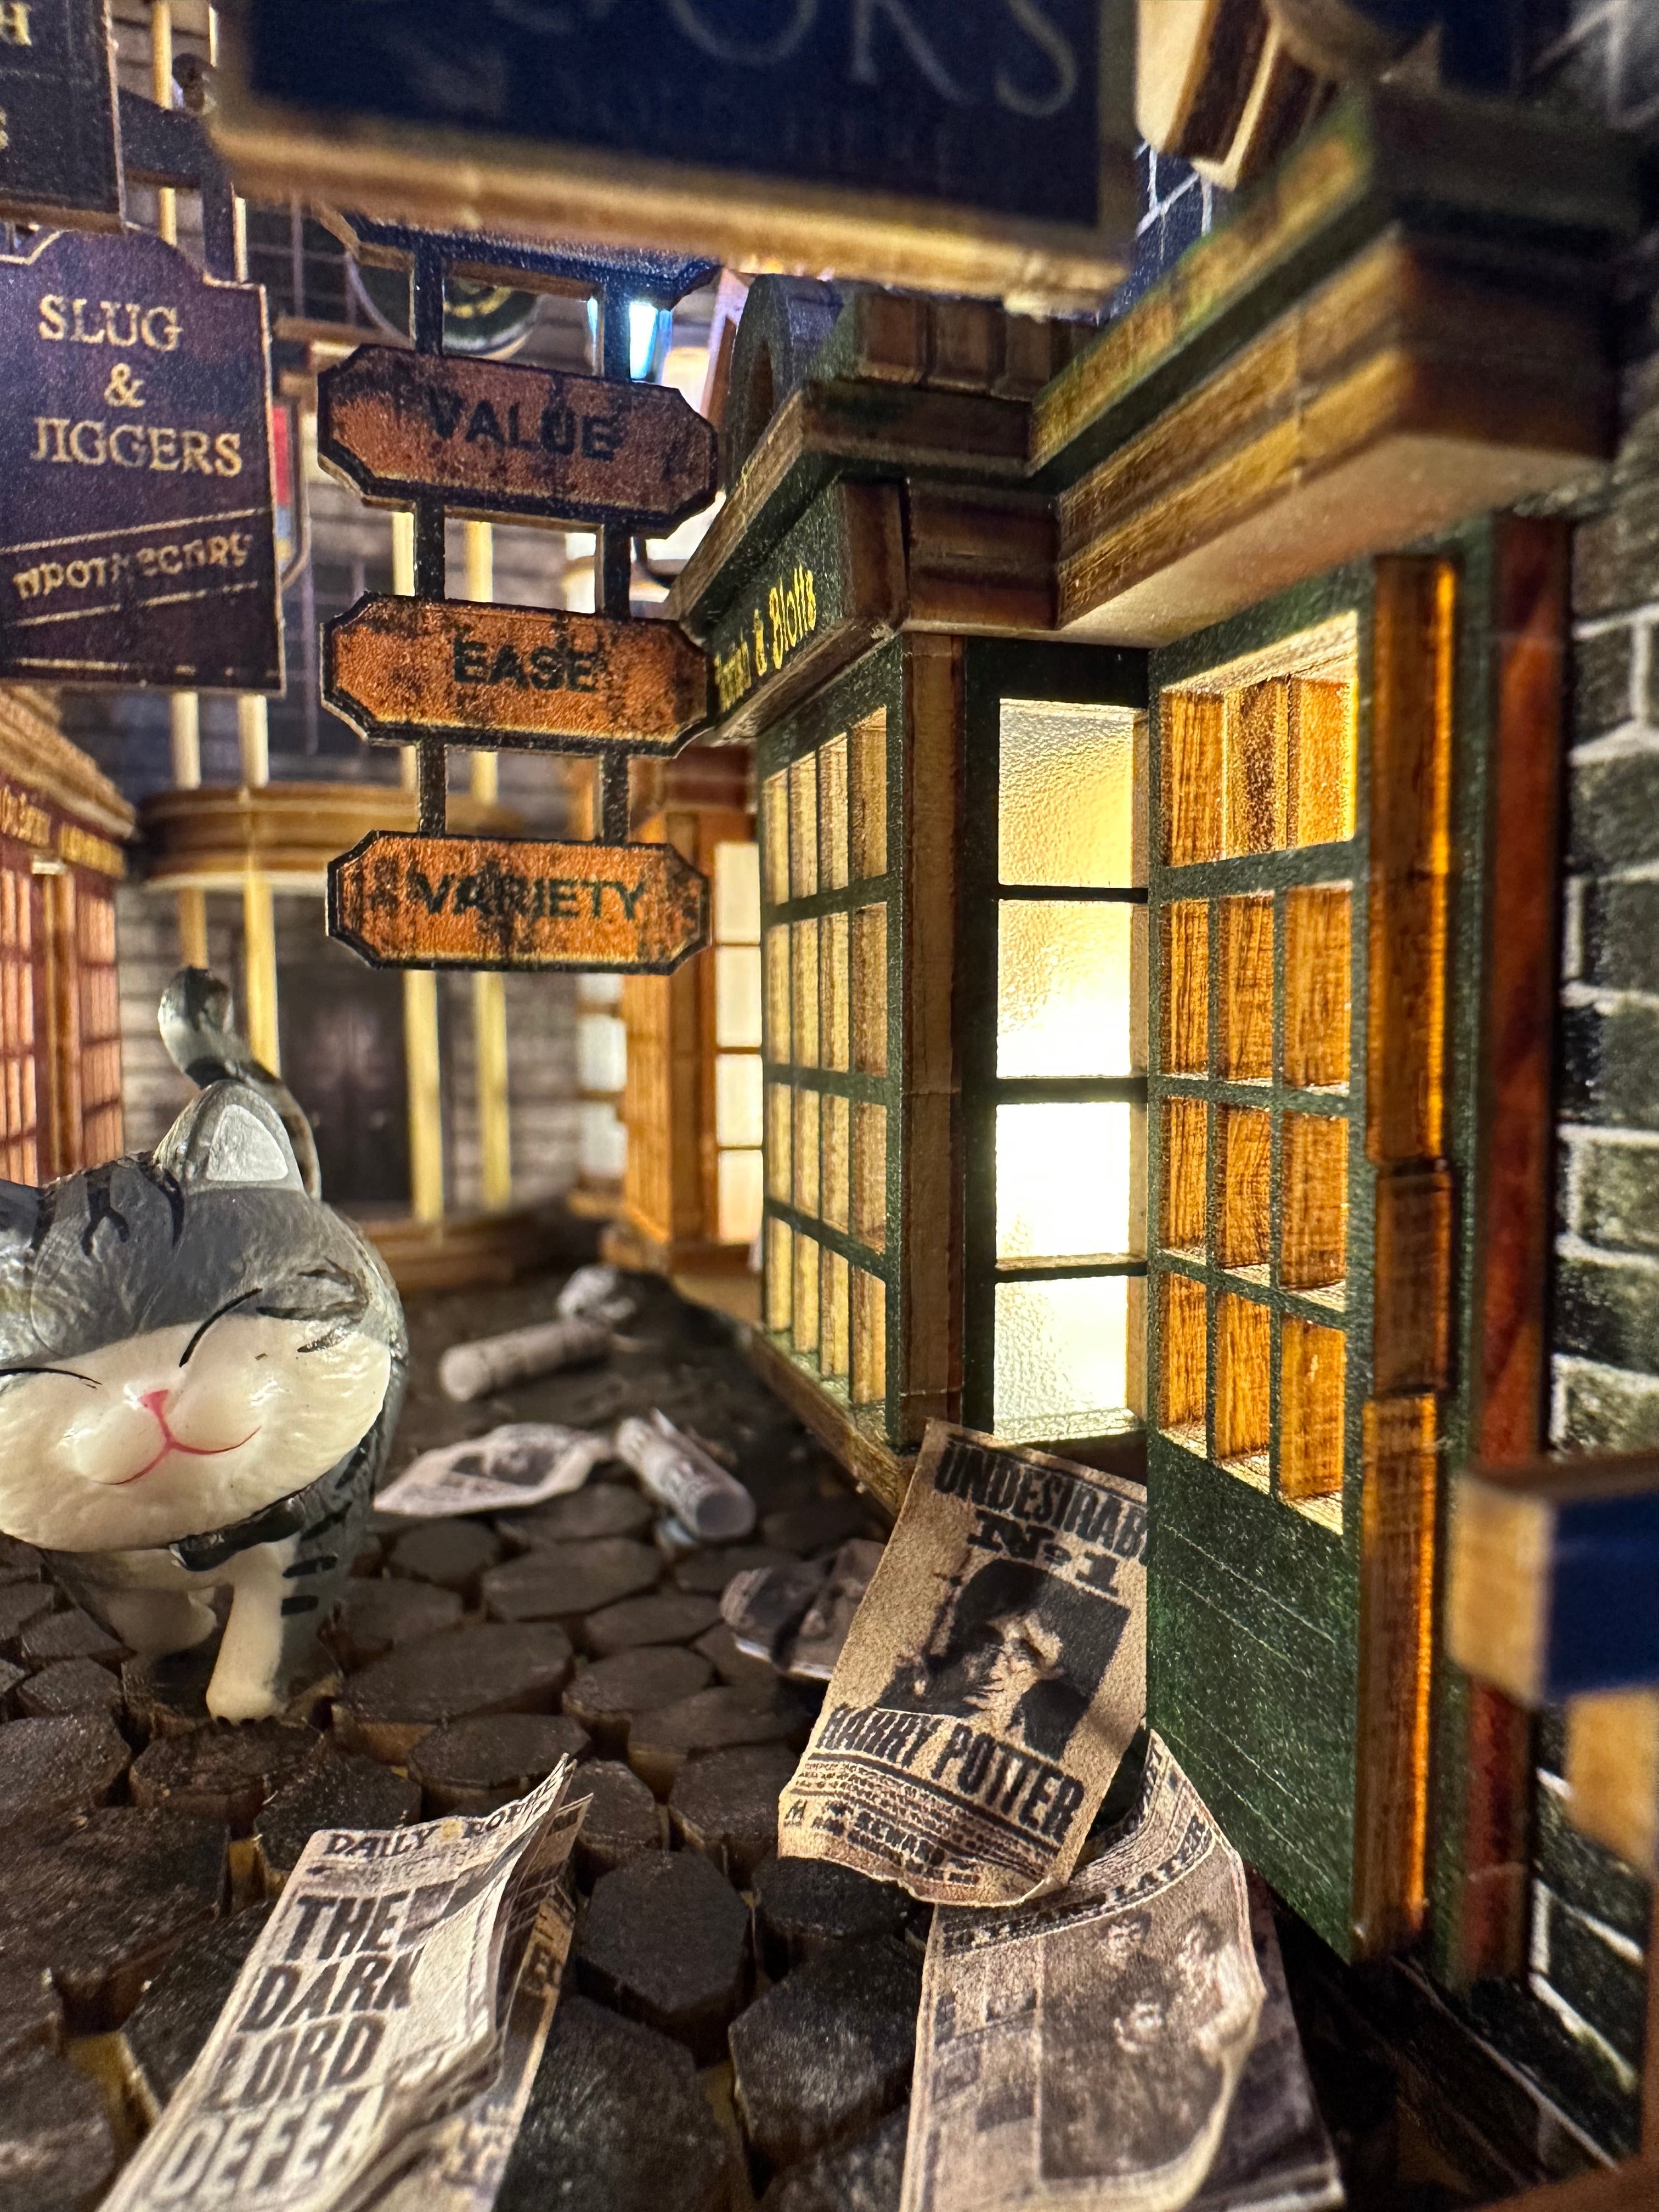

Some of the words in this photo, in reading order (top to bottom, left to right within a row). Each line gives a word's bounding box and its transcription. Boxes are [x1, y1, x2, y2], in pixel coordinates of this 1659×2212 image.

[38, 294, 183, 352] SLUG
[104, 363, 145, 408] &
[30, 417, 242, 477] JIGGERS
[430, 387, 623, 462] VALUE
[454, 640, 599, 692] EASE
[411, 871, 646, 921] VARIETY
[814, 1702, 944, 1769] HARRY
[932, 1723, 1084, 1843] POTTER
[324, 1825, 441, 1857] DAILY
[284, 1888, 410, 1961] THE
